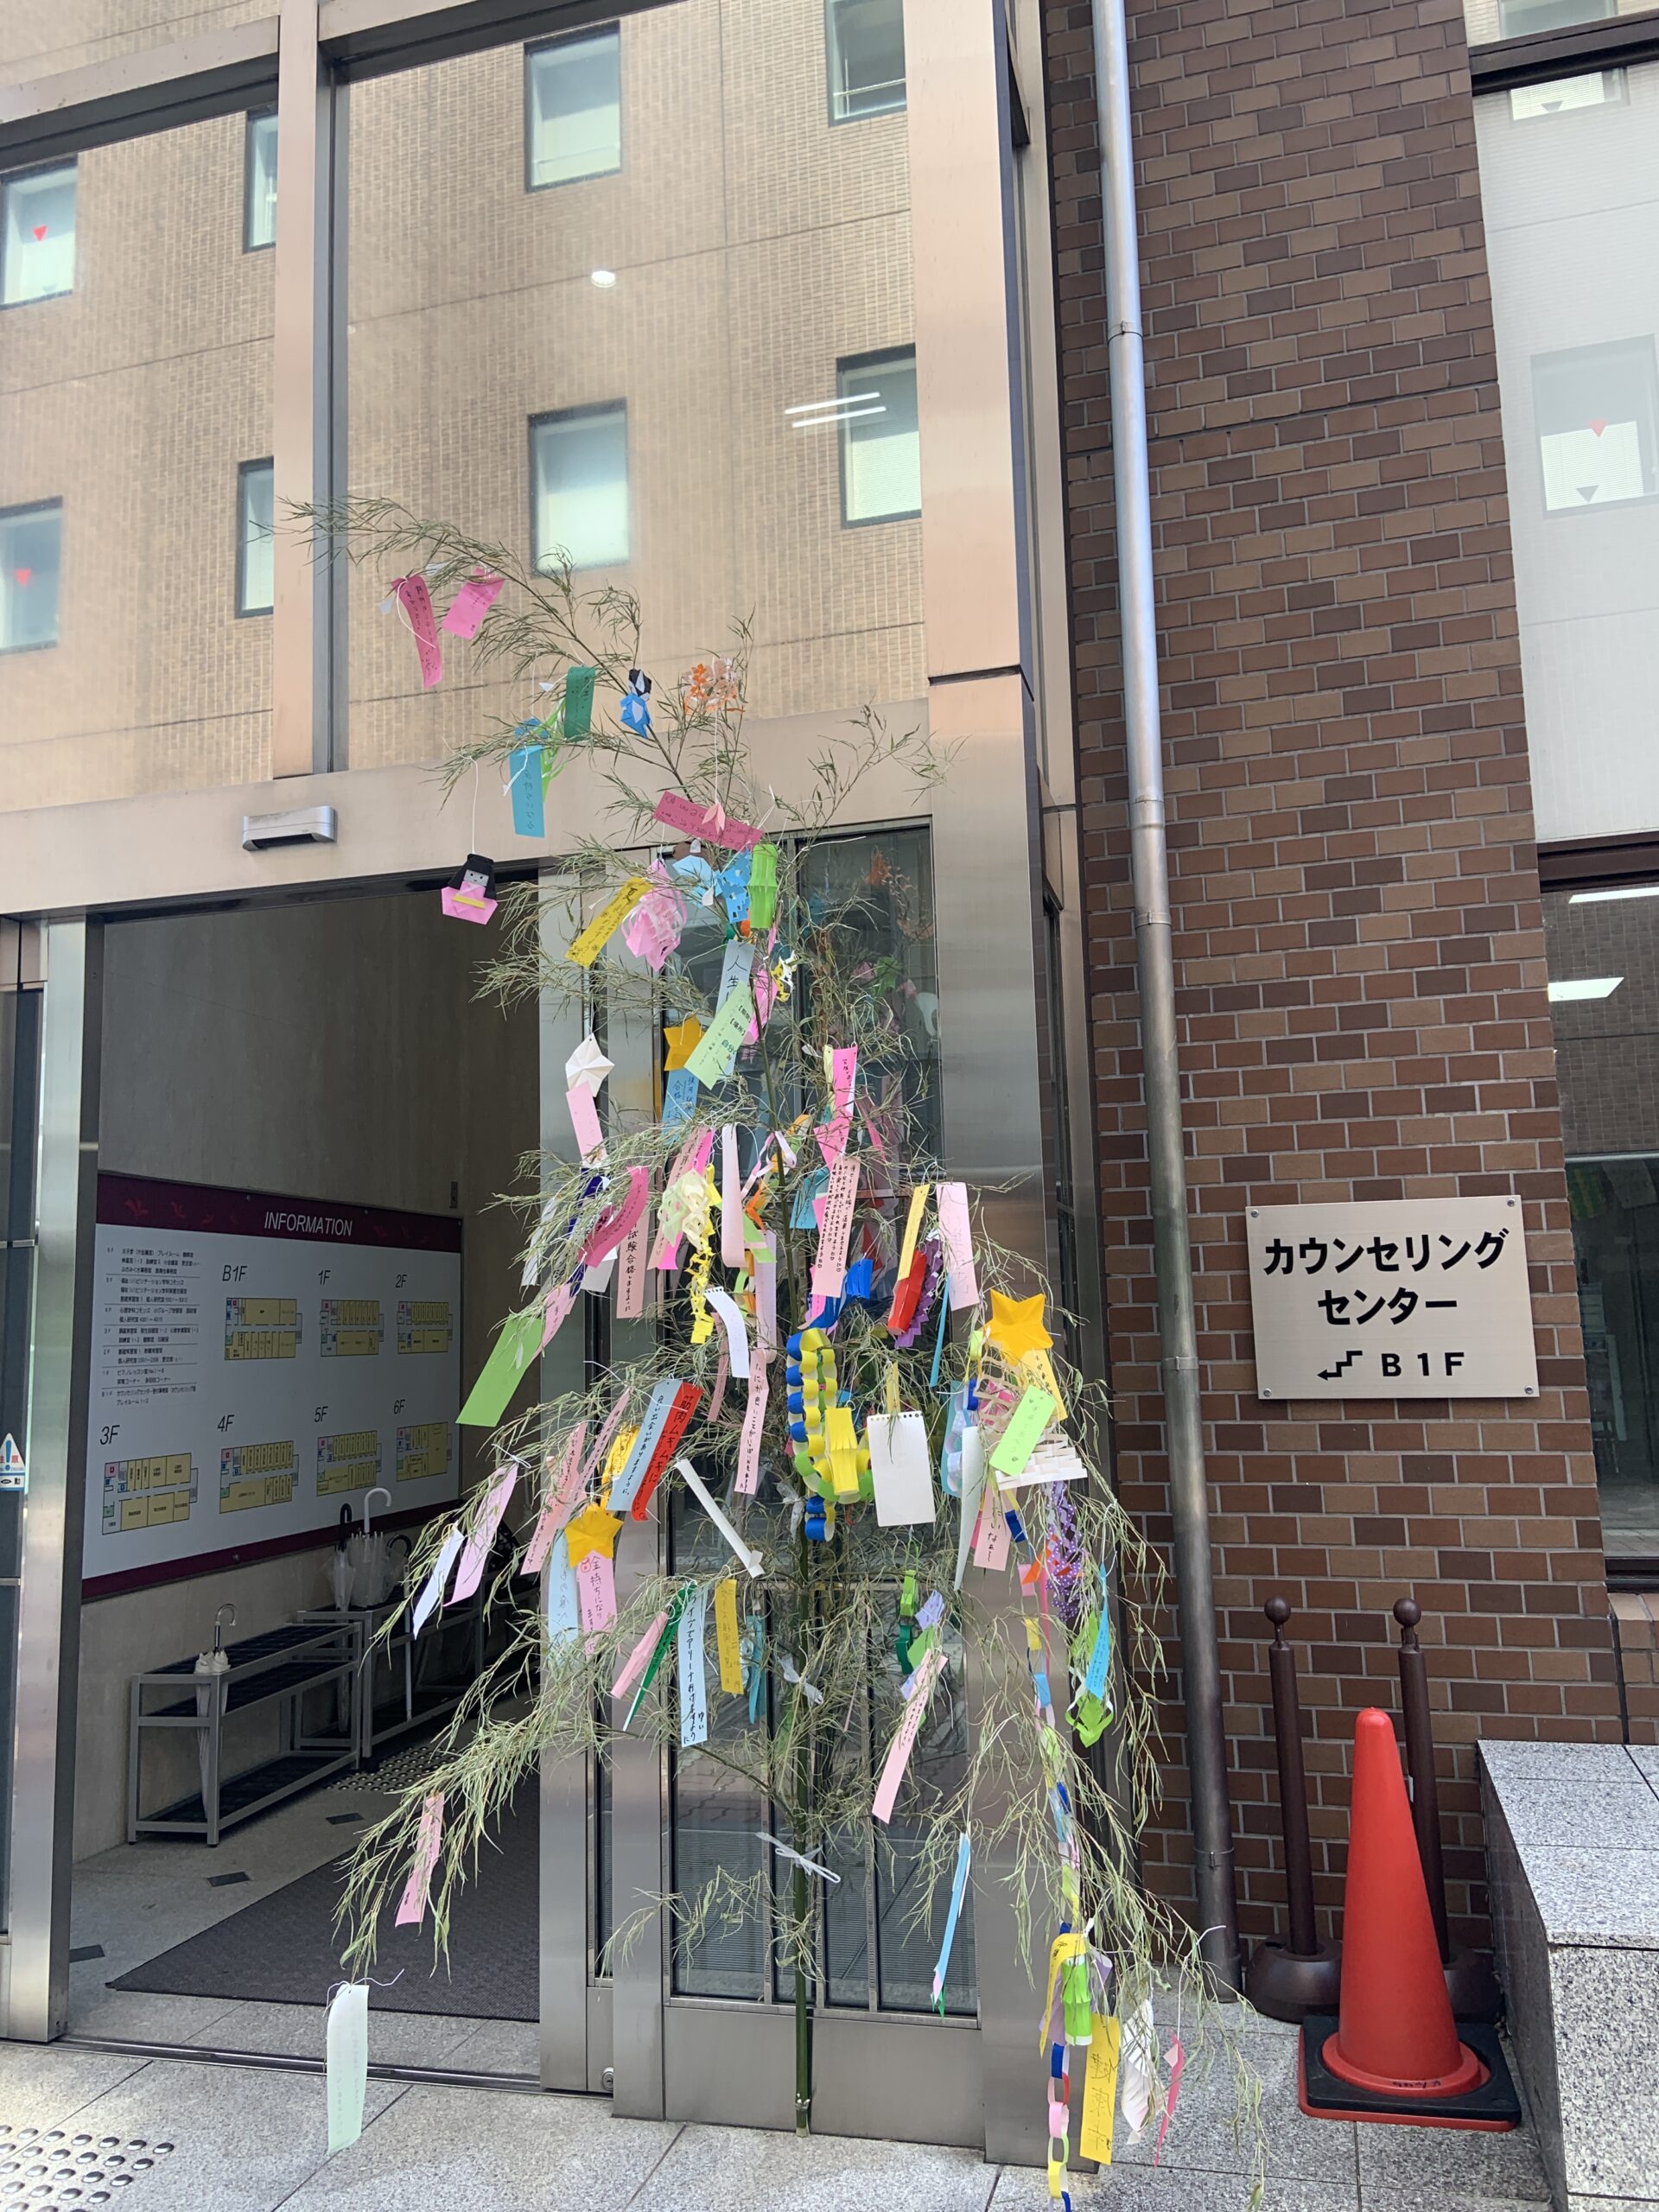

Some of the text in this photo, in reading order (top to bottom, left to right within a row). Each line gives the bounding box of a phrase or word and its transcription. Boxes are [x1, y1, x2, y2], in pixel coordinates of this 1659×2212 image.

[264, 1211, 353, 1237] INFORMATION
[1263, 1228, 1510, 1275] カウンセリング
[222, 1265, 248, 1282] B1F
[318, 1269, 332, 1286] 1F
[395, 1274, 408, 1288] 2F
[1317, 1287, 1458, 1325] センター
[314, 1406, 329, 1423] 5F
[393, 1399, 406, 1415] 6F
[217, 1414, 235, 1433] 4F
[99, 1424, 120, 1446] 3F
